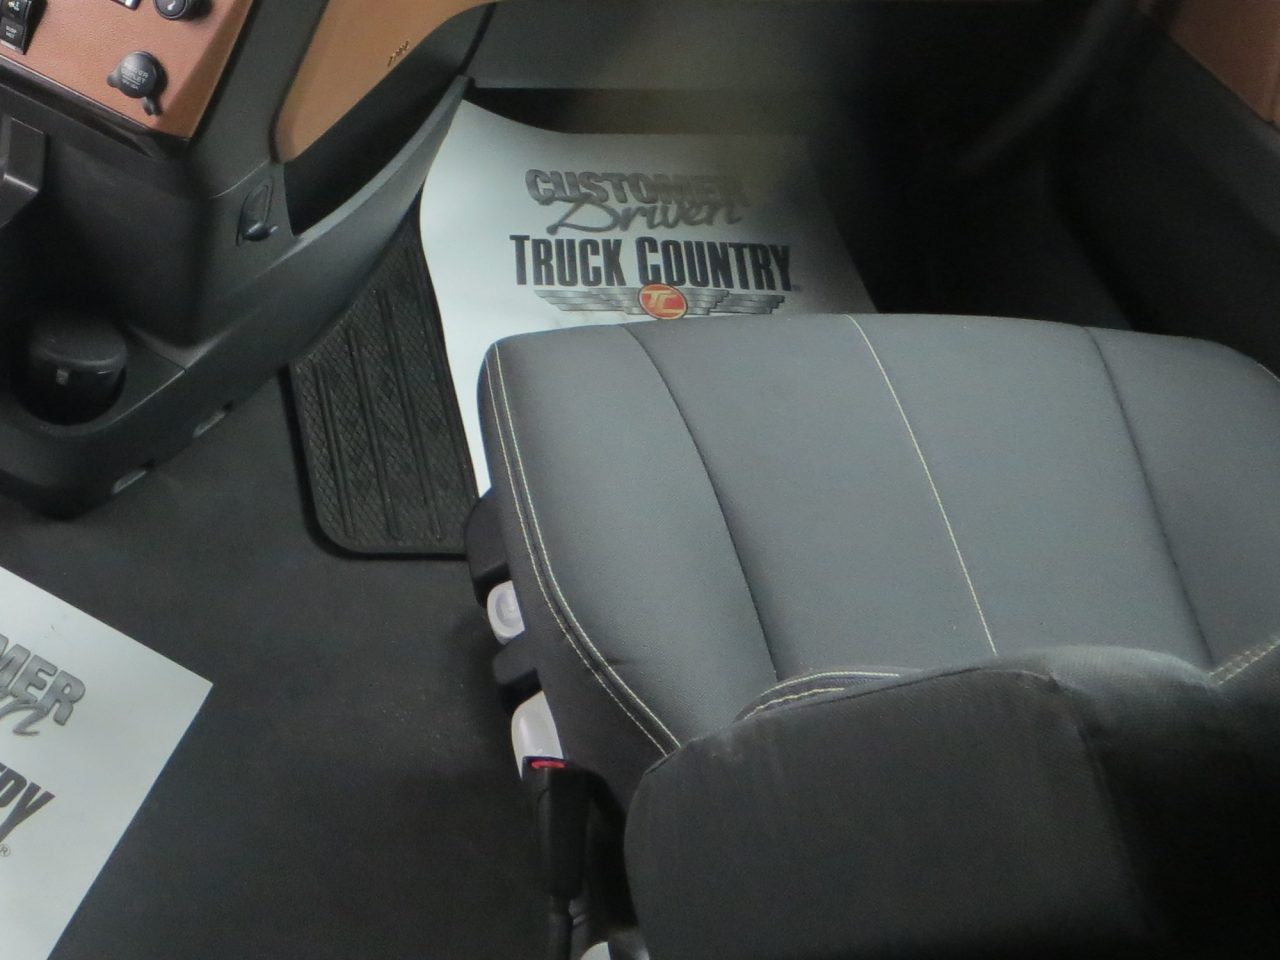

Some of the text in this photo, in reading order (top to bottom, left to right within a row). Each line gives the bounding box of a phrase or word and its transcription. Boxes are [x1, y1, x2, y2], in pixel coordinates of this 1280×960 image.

[525, 168, 750, 207] CUSTOMER
[537, 193, 743, 236] Driven
[509, 234, 792, 292] TRUCK COUNTRY
